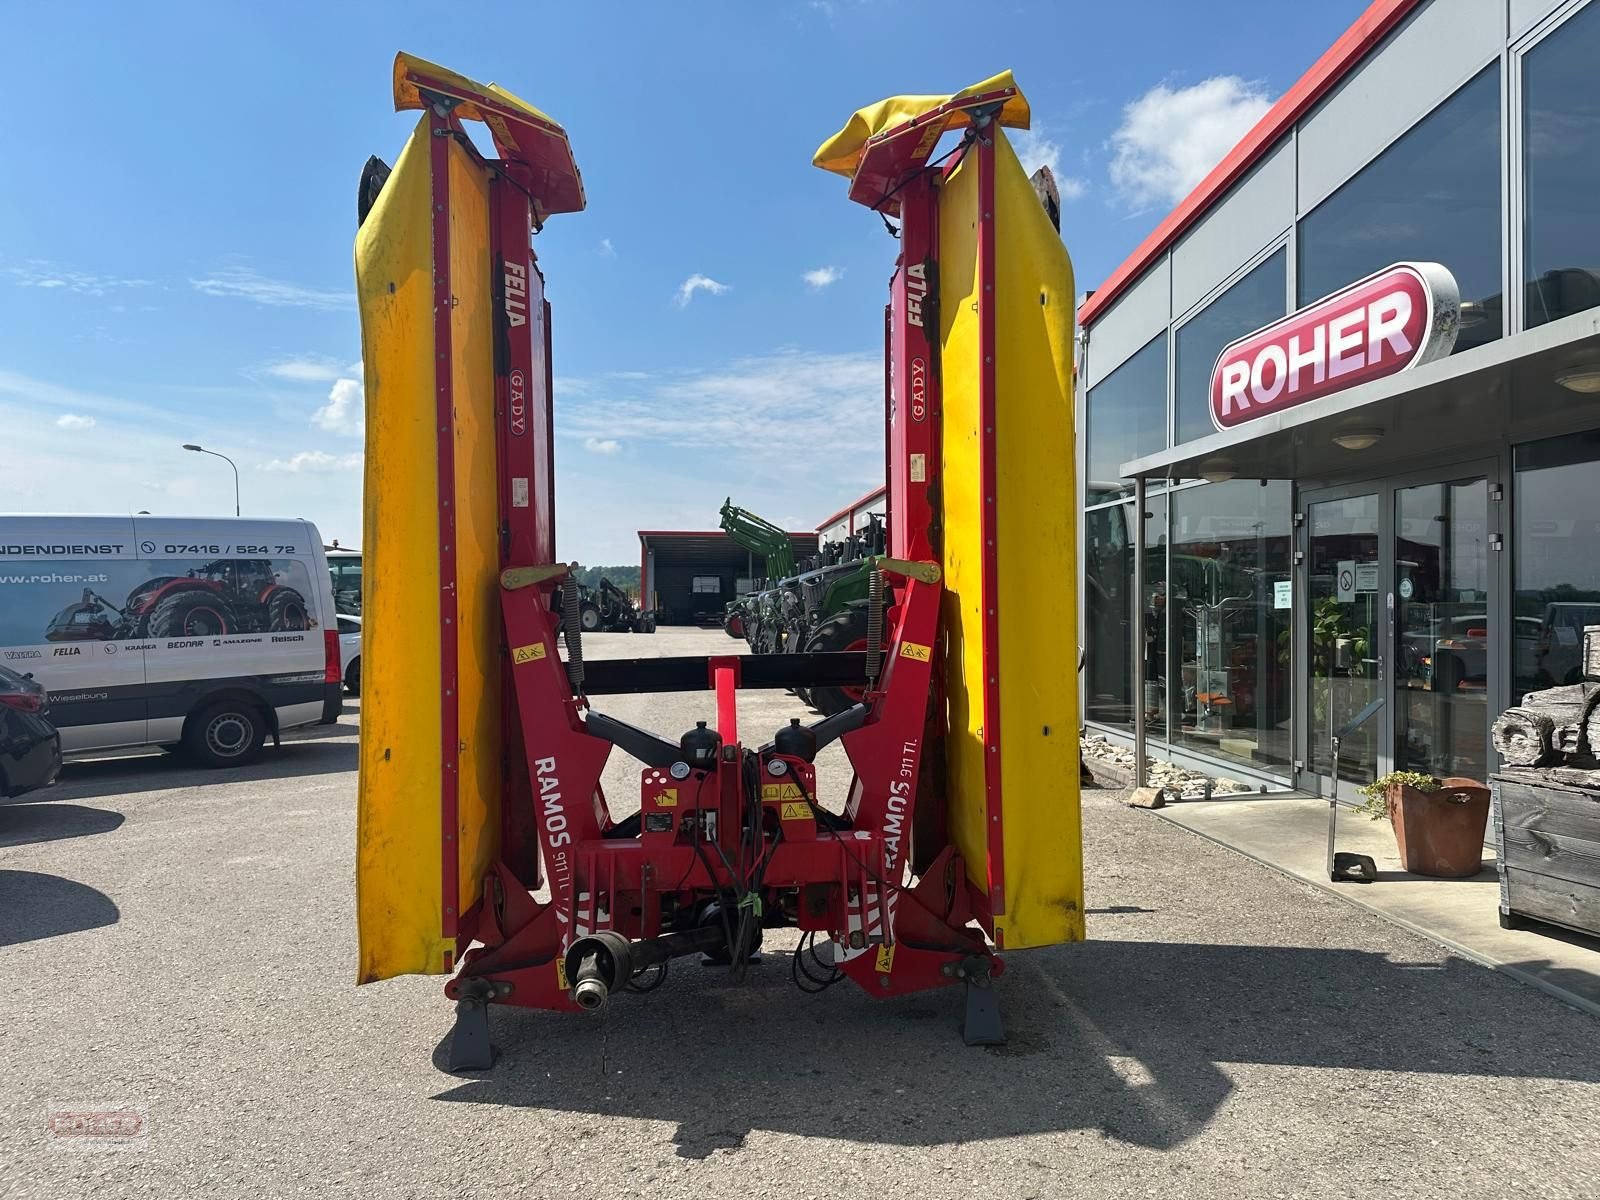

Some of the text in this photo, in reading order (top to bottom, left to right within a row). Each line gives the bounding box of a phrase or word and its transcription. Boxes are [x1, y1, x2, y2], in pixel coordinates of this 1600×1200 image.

[504, 261, 526, 328] FELLA
[1221, 290, 1413, 417] ROHER
[913, 362, 925, 417] GADY
[511, 374, 525, 434] GADY
[164, 544, 220, 554] 07416
[236, 545, 268, 554] 524
[274, 545, 296, 554] 72
[167, 640, 204, 649] BEDNAR
[222, 637, 263, 645] AMAZONE
[4, 650, 42, 660] VALTRA
[53, 647, 81, 657] FELLA
[50, 692, 108, 703] Wieselburg
[534, 756, 572, 848] RAMOS
